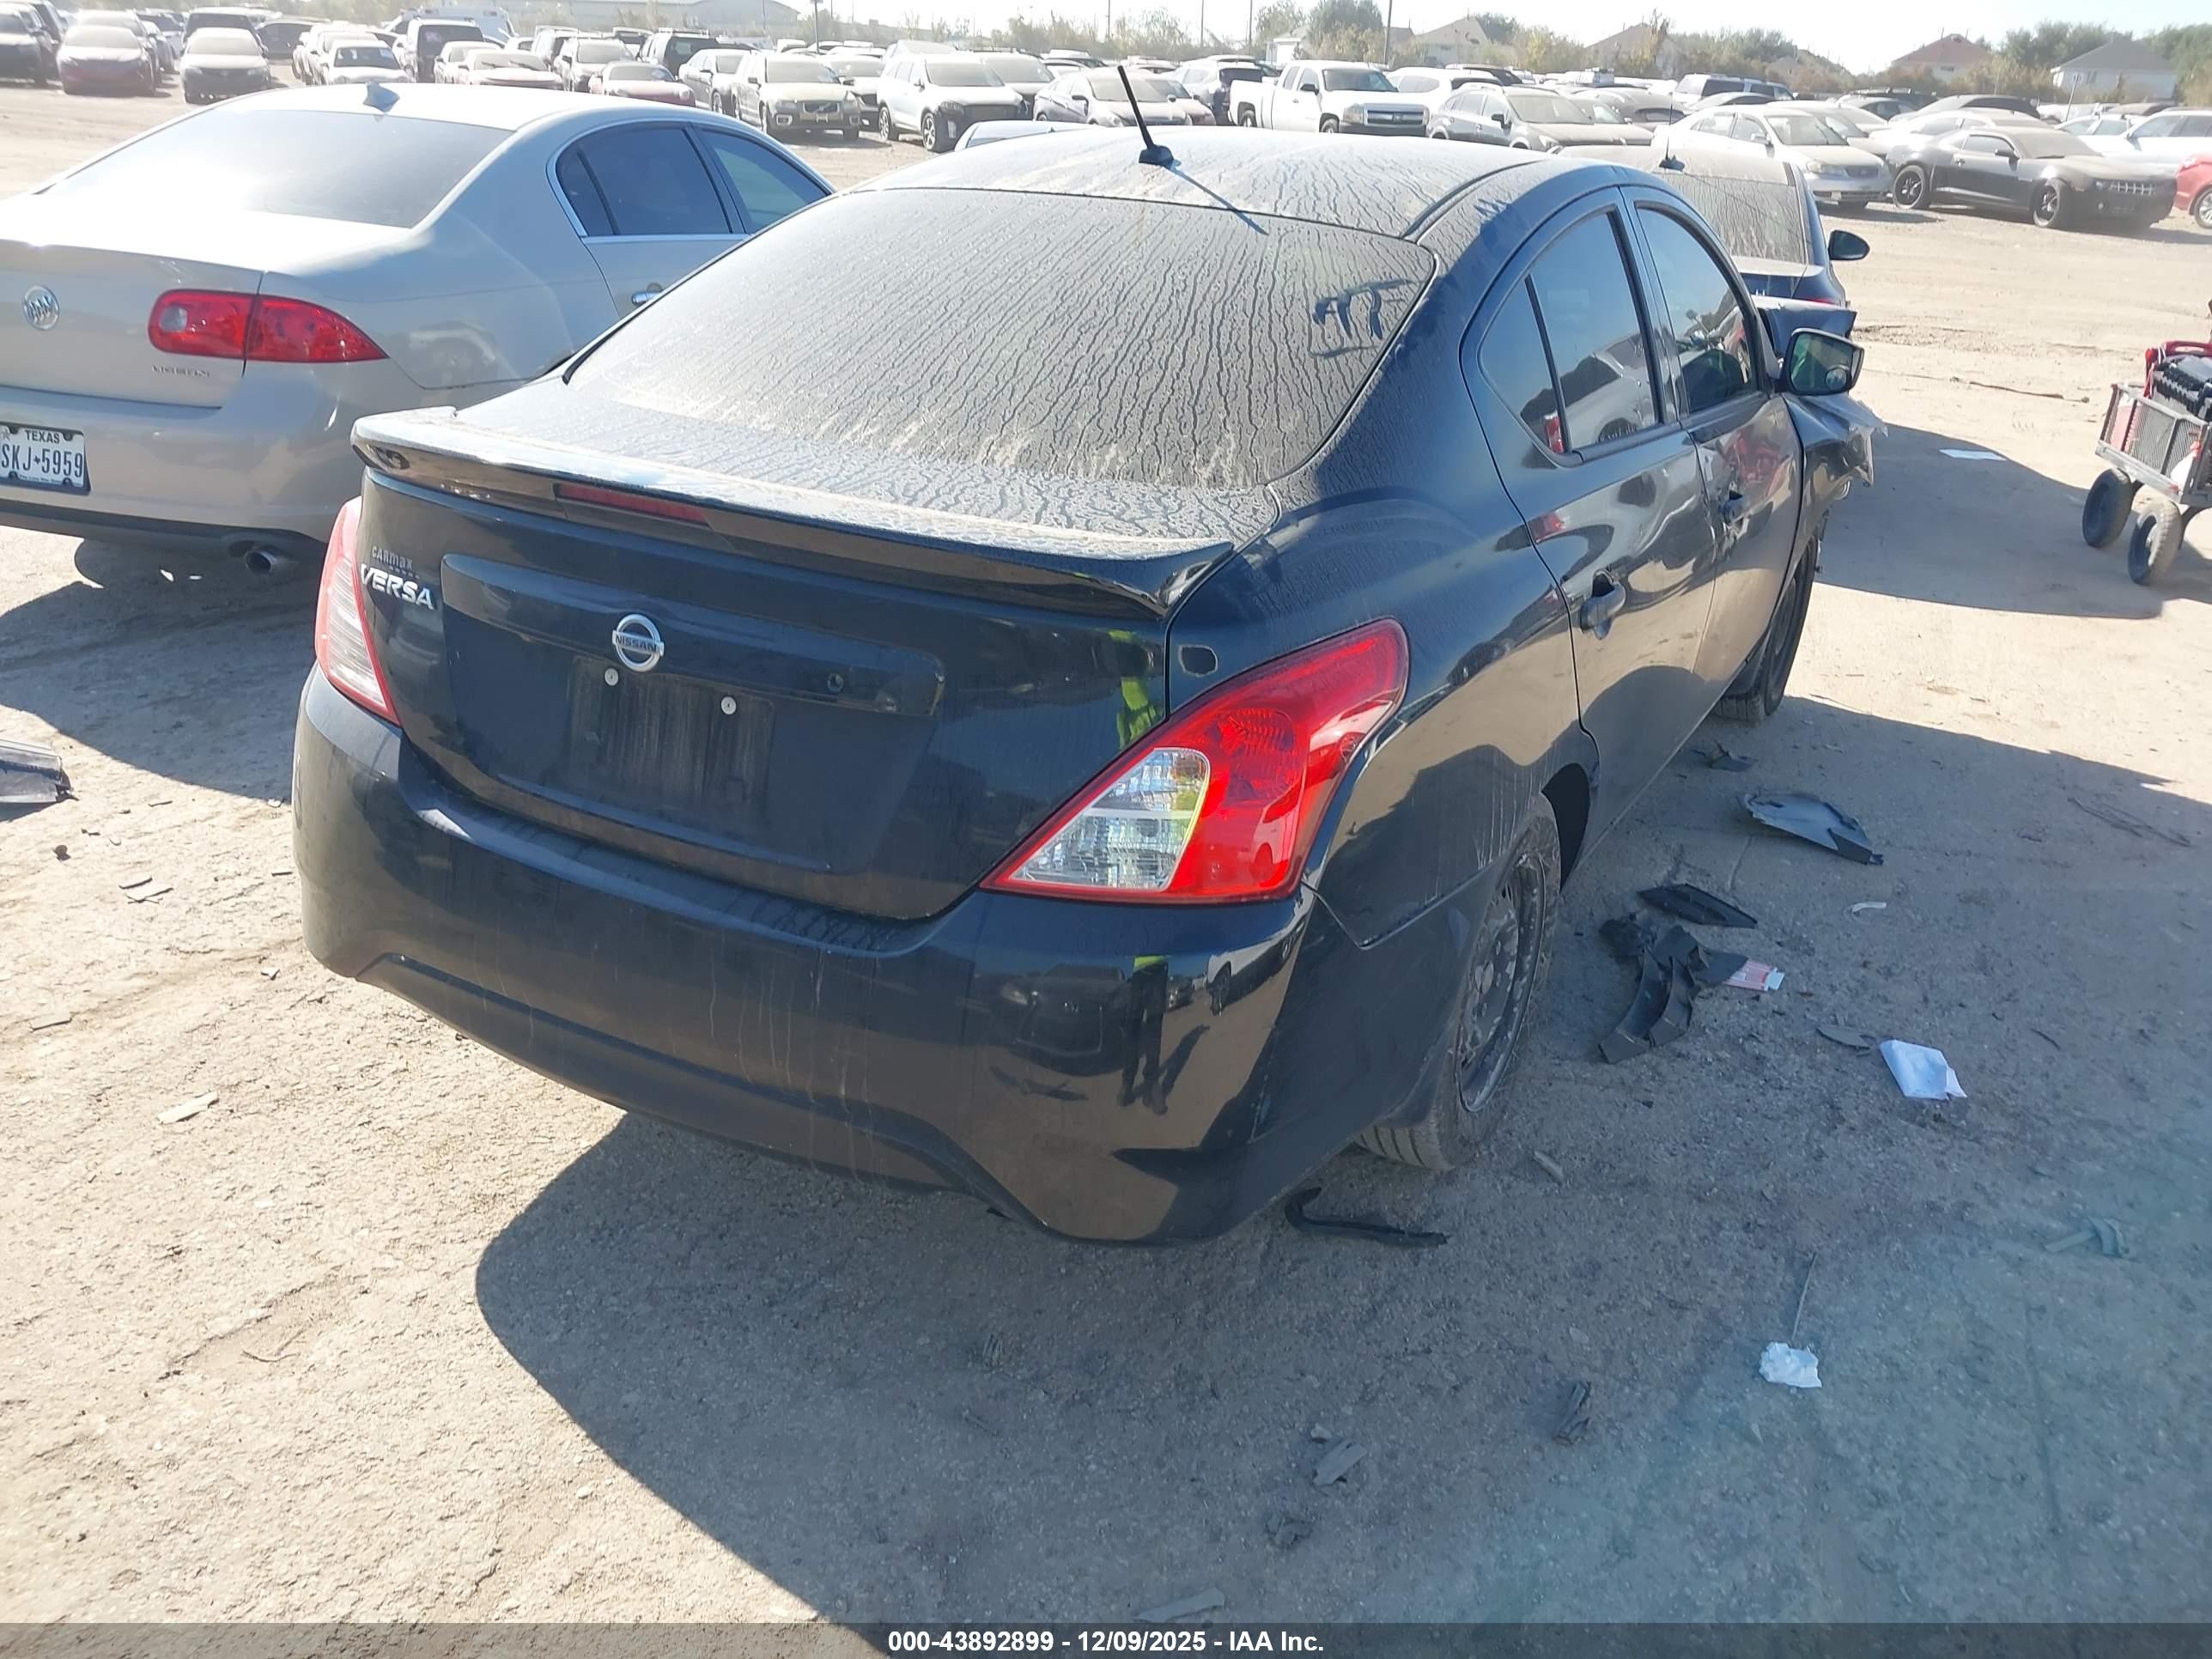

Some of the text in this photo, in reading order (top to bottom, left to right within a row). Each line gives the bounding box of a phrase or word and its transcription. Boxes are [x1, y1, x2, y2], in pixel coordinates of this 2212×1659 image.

[25, 429, 60, 443] TEXAS
[361, 563, 434, 611] VERSA
[616, 635, 656, 653] NISSAN
